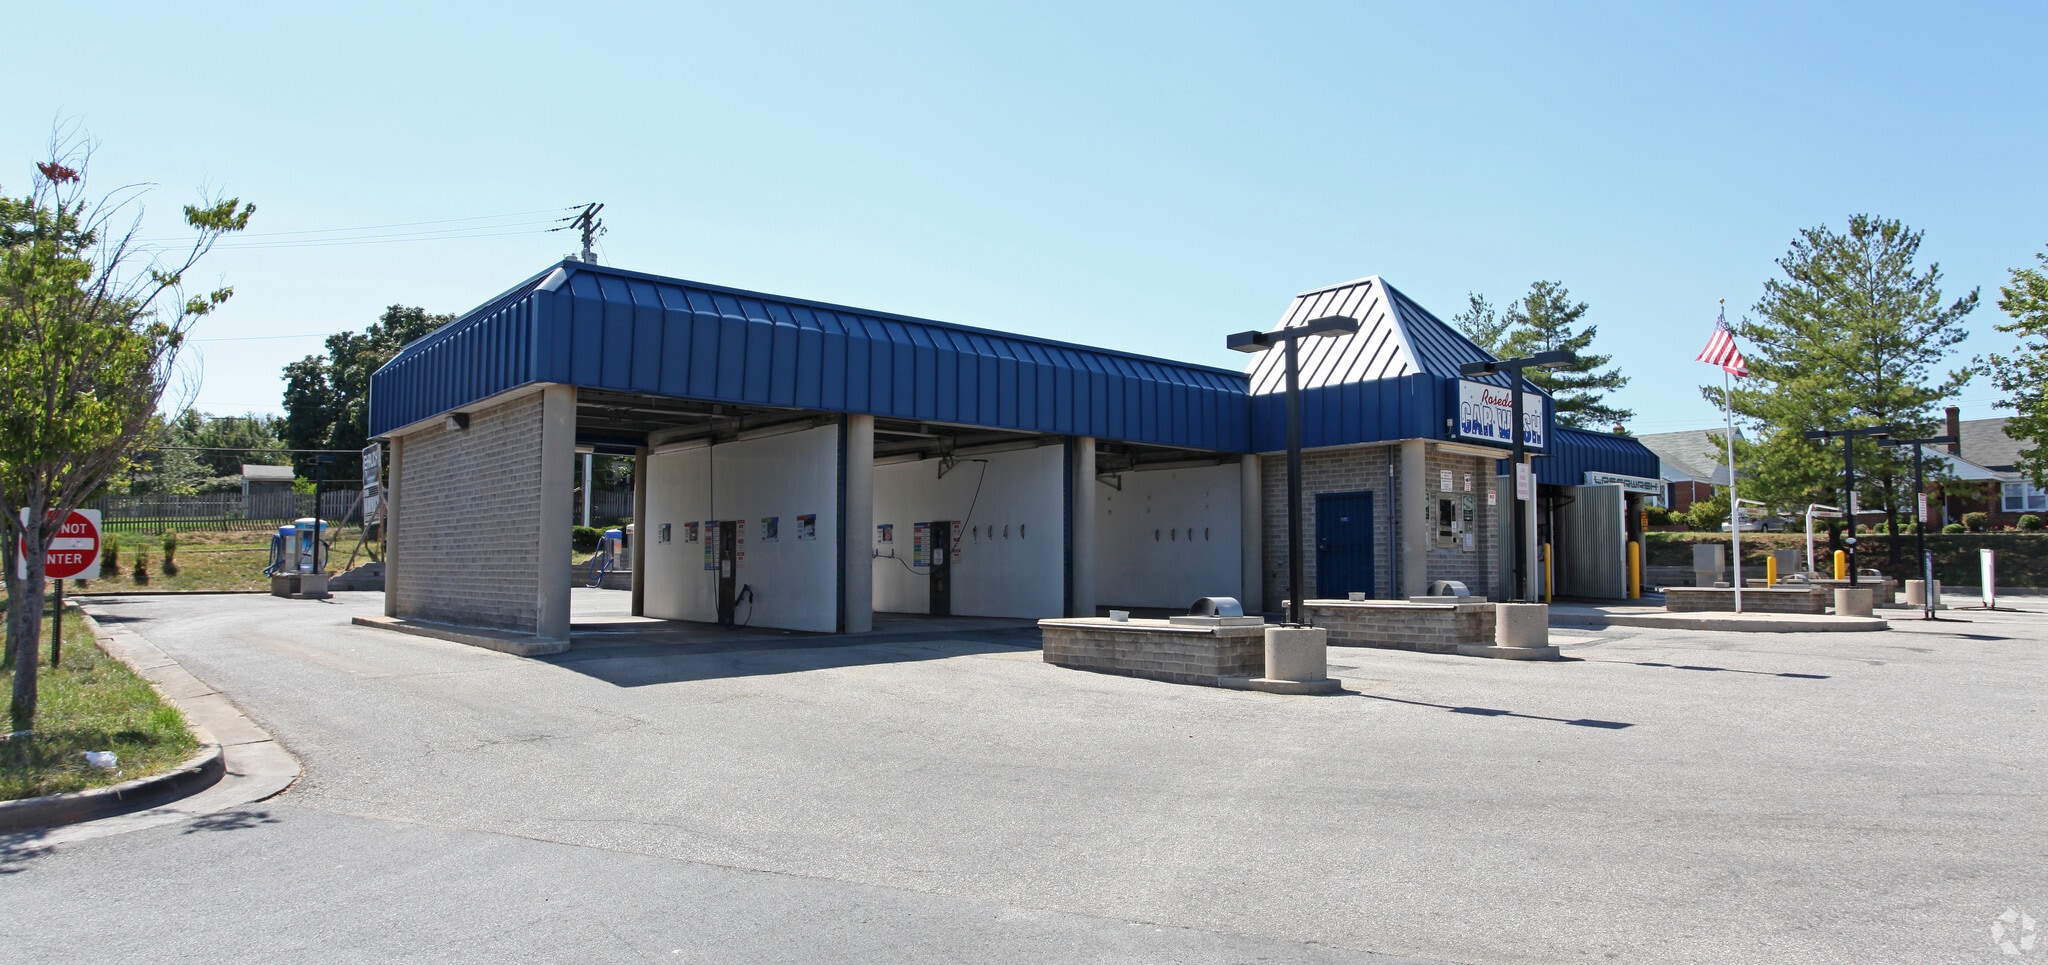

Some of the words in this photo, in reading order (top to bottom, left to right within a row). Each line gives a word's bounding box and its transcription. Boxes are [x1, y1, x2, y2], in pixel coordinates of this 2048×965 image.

[1482, 388, 1513, 408] Roseda
[1461, 401, 1493, 437] CAR
[1497, 408, 1541, 444] WSH
[61, 523, 87, 534] NOT
[47, 553, 82, 565] NTER
